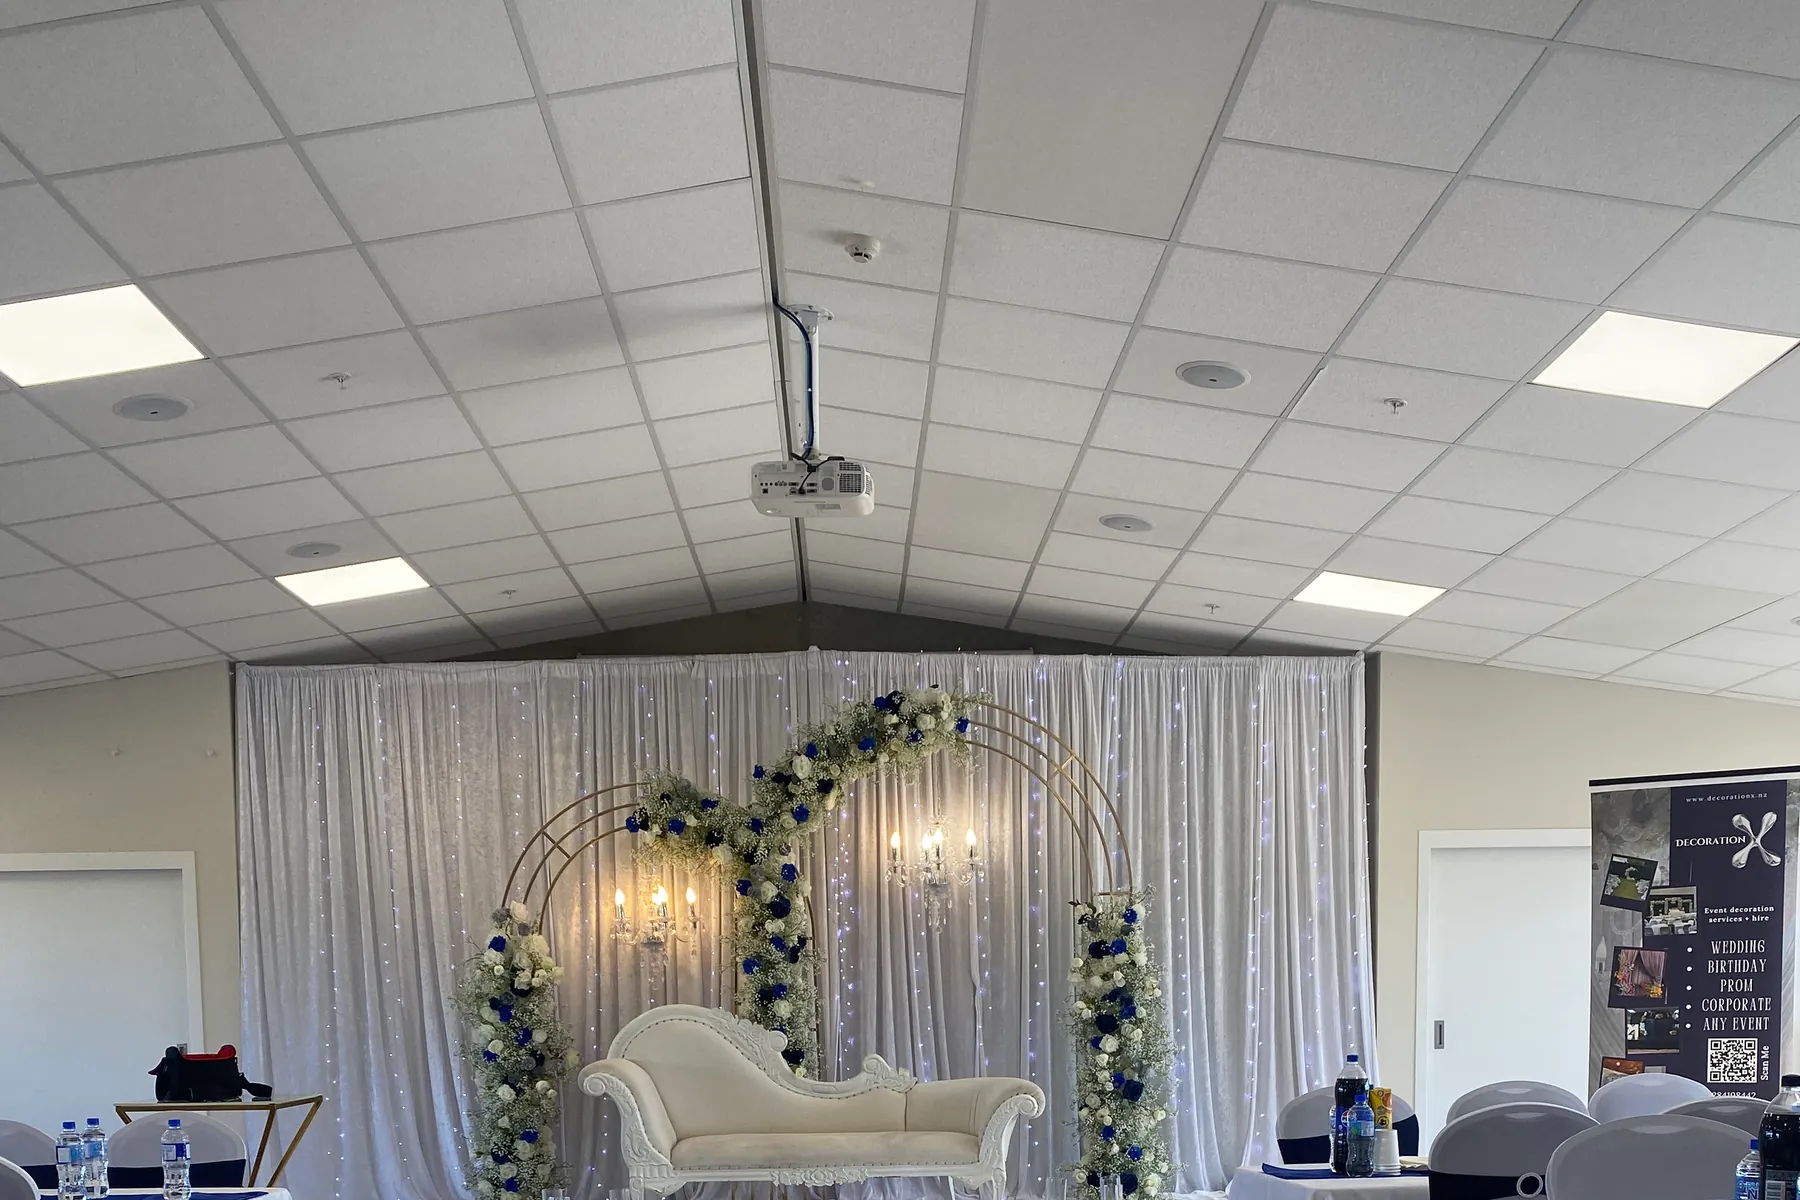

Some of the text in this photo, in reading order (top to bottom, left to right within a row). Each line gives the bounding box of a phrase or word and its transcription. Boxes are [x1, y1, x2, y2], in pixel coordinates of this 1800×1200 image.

[1674, 835, 1746, 847] DECORATION
[1729, 905, 1775, 913] decoration
[1708, 915, 1743, 923] services
[1751, 914, 1770, 922] hire
[1711, 939, 1766, 954] WEDDING
[1708, 959, 1767, 974] BIRTHDAY
[1720, 978, 1753, 992] PROM
[1701, 997, 1772, 1012] CORPORATE
[1703, 1016, 1770, 1031] ANY EVENT
[1760, 1045, 1770, 1081] Scan Me
